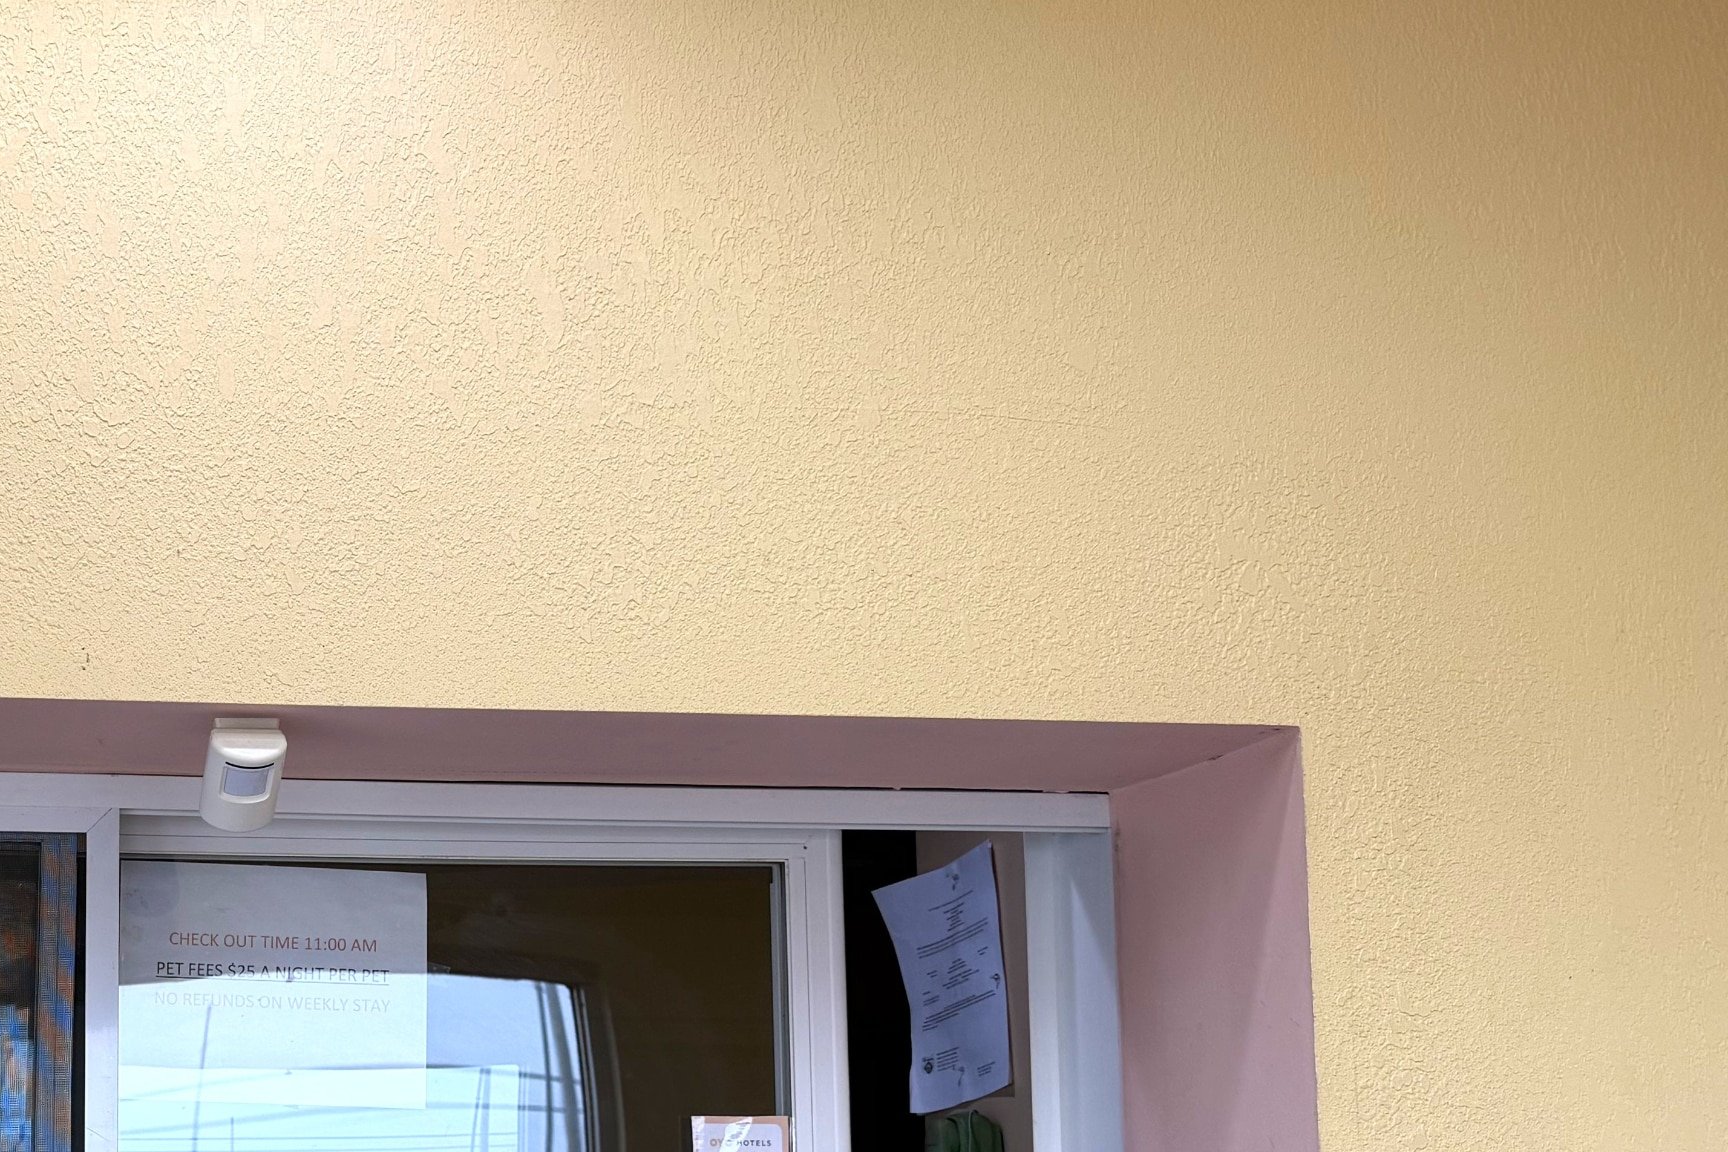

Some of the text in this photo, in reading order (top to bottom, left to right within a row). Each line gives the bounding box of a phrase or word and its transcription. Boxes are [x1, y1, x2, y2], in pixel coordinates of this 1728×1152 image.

[169, 931, 378, 953] CHECK OUT TIME 11:00 AM
[156, 961, 390, 984] PET FEES $25 A NIGHT PER PET
[154, 991, 391, 1014] NO REFUNDS ON WEEKLY STAY
